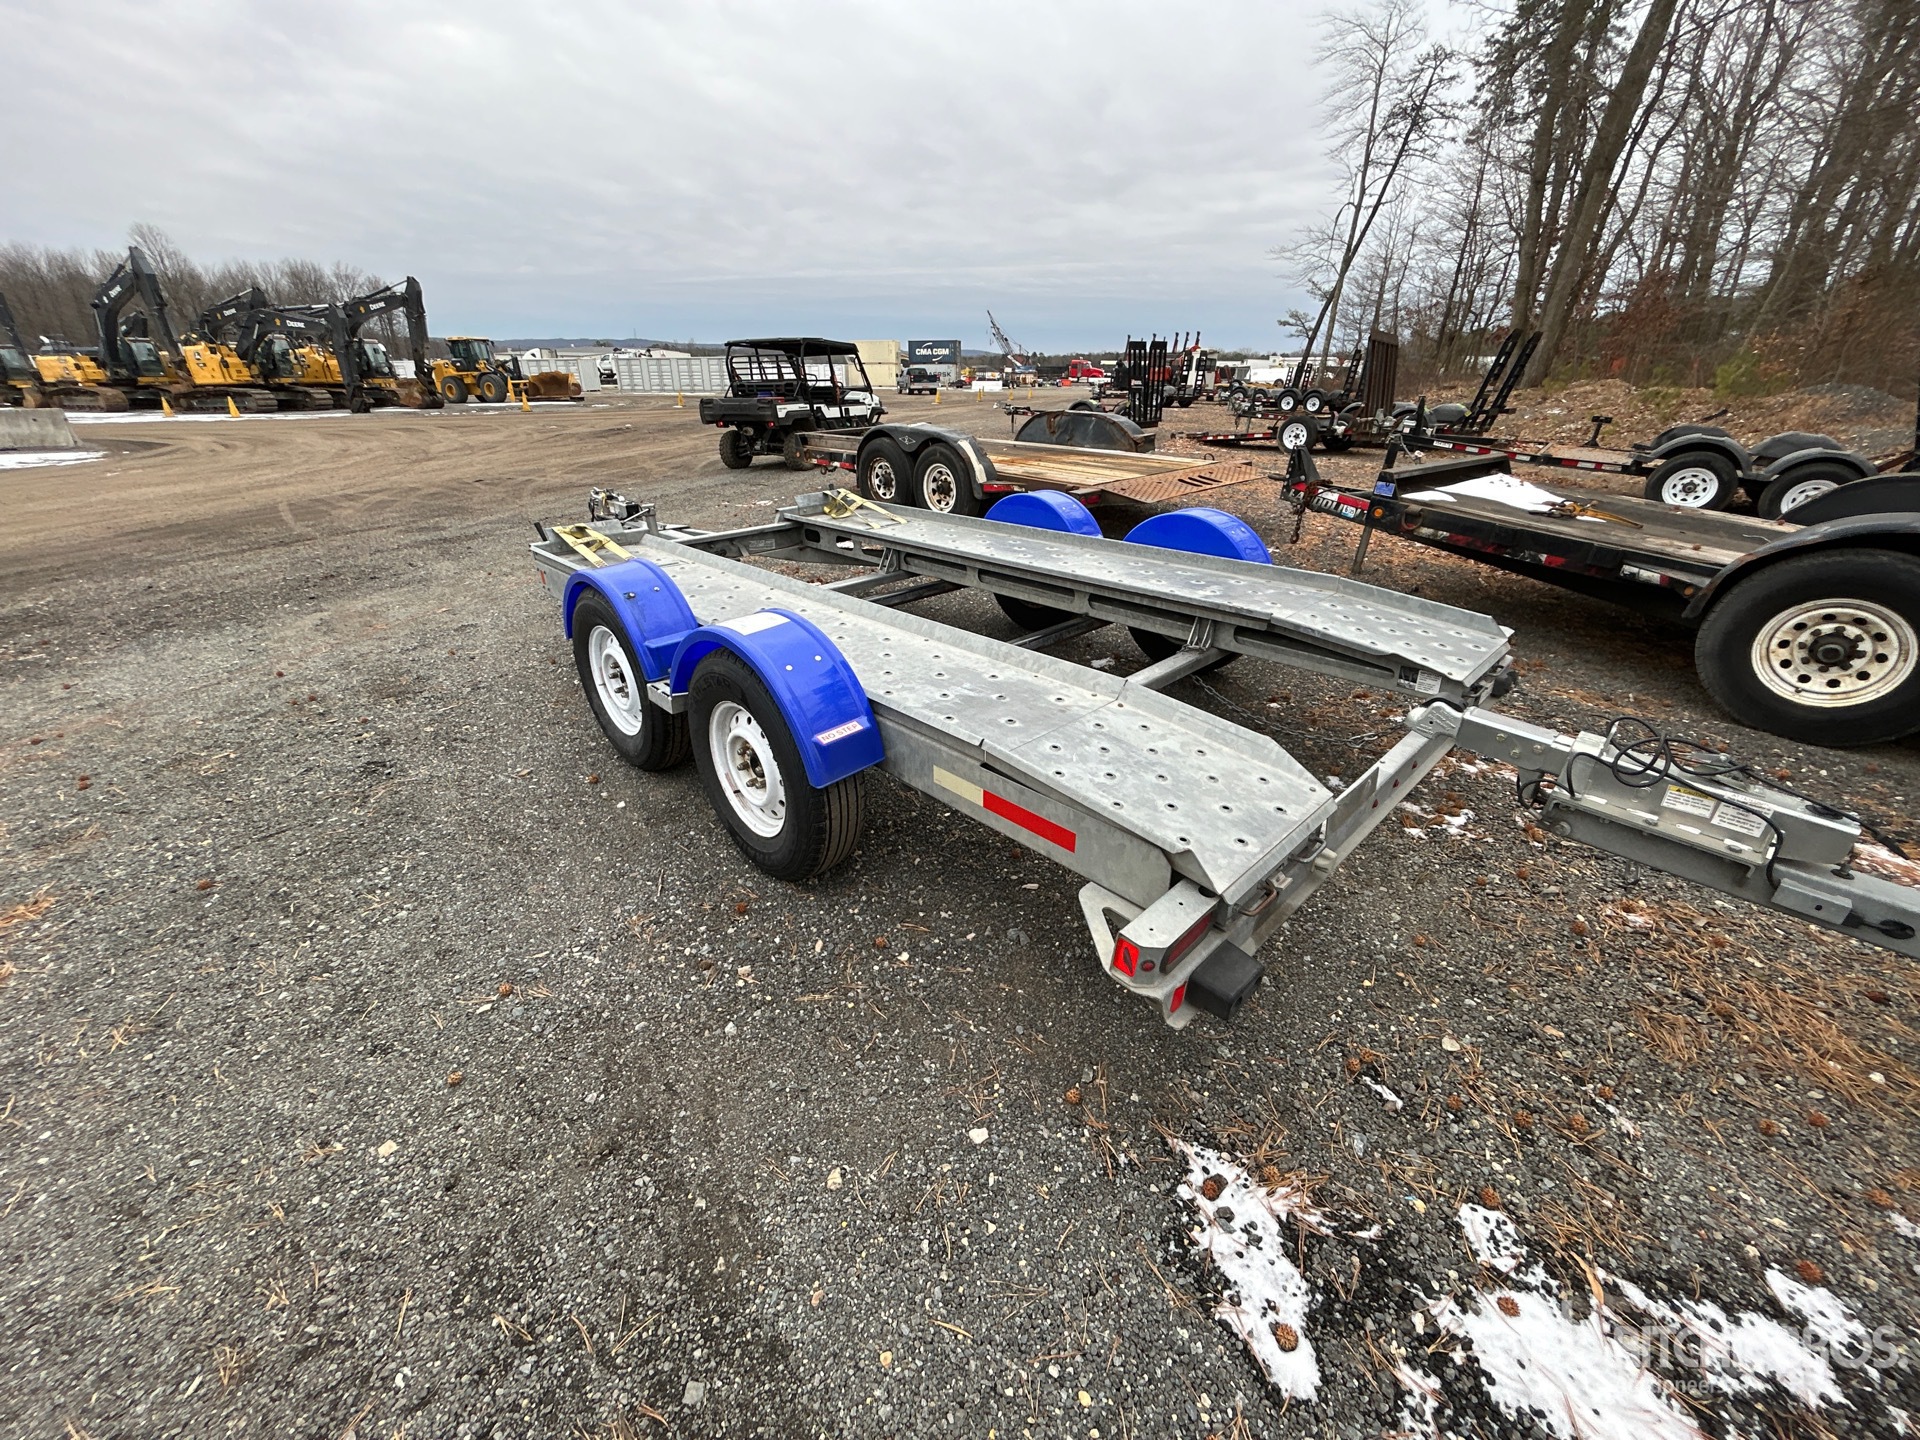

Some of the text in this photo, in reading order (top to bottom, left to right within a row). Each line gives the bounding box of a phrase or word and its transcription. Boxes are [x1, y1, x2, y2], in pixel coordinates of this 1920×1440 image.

[369, 301, 386, 310] DEERE
[223, 307, 237, 317] DEERE
[285, 319, 306, 329] DEERE
[821, 723, 858, 741] NO STEP
